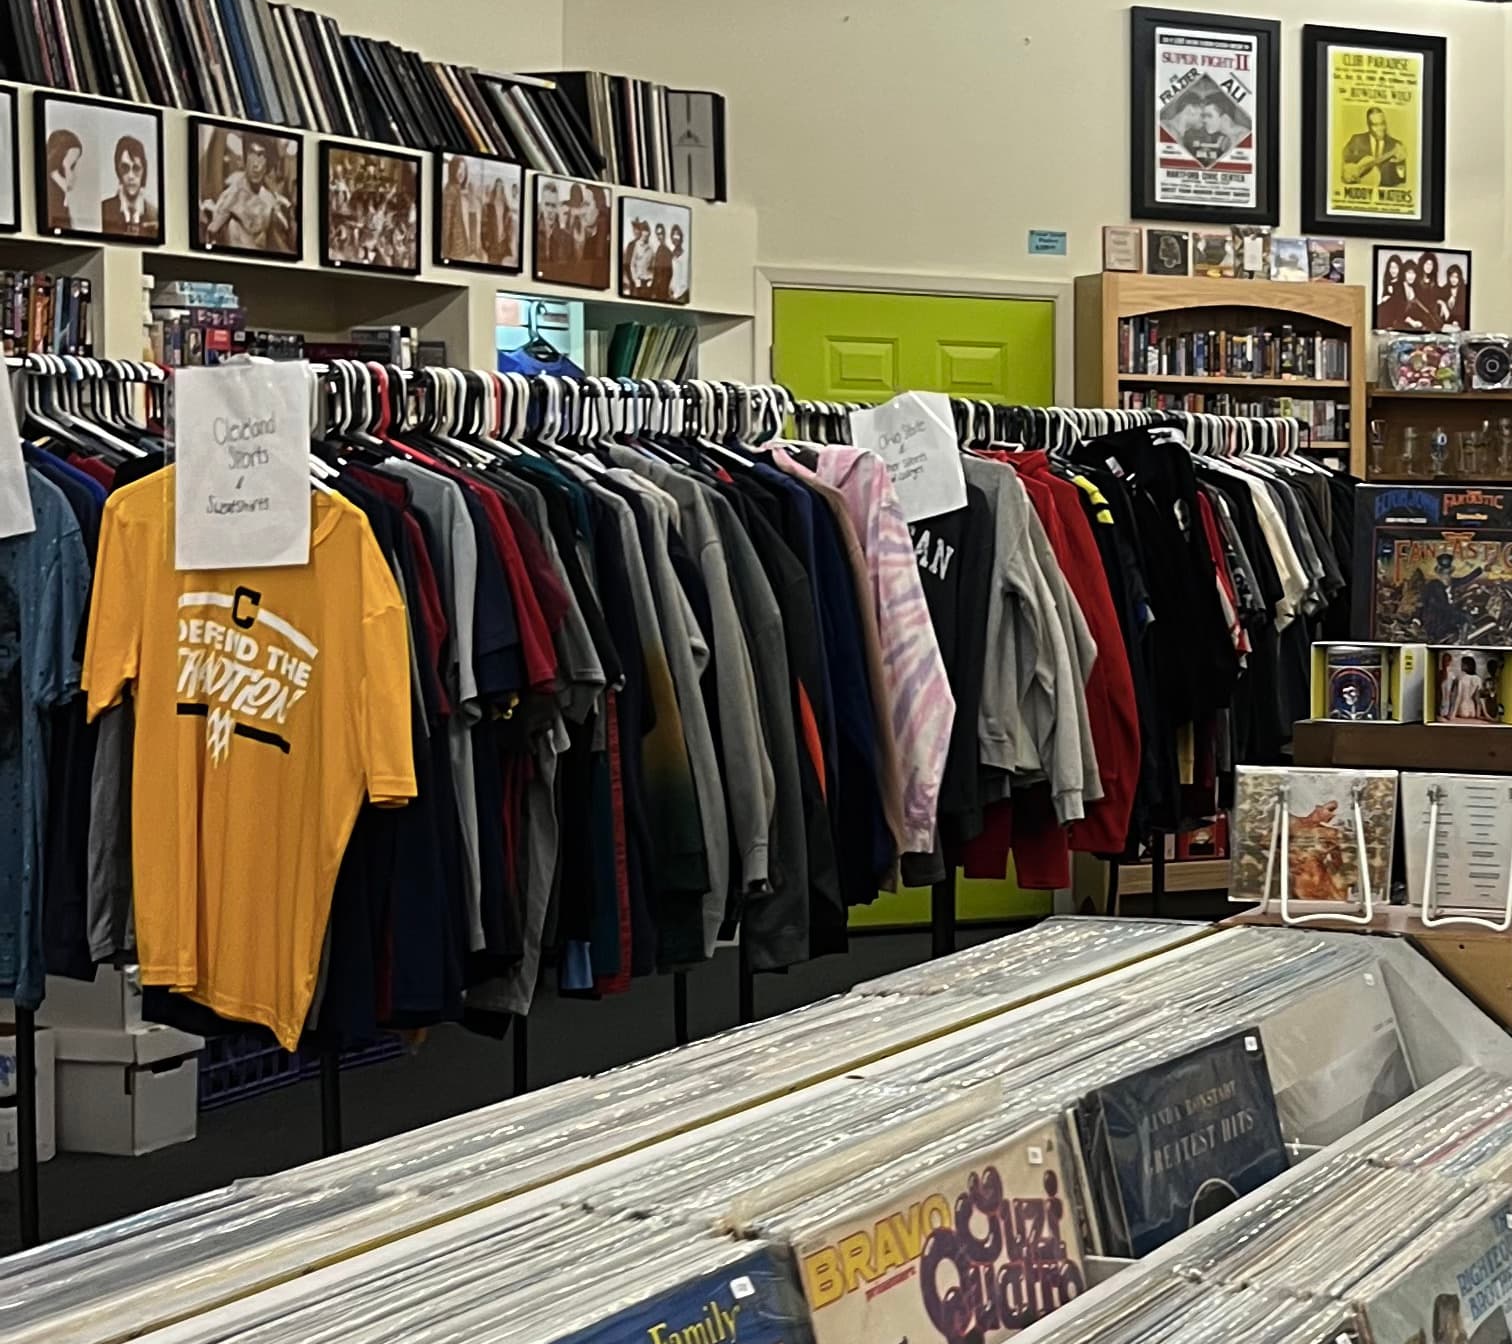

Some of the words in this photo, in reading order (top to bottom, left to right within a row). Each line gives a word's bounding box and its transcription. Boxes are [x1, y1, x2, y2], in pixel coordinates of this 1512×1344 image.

[1159, 67, 1200, 105] FRAZIER
[1220, 78, 1247, 103] ALI
[909, 524, 955, 581] AN
[266, 645, 312, 688] THE
[1220, 1110, 1255, 1144] HITS
[803, 1193, 950, 1312] BRAVO
